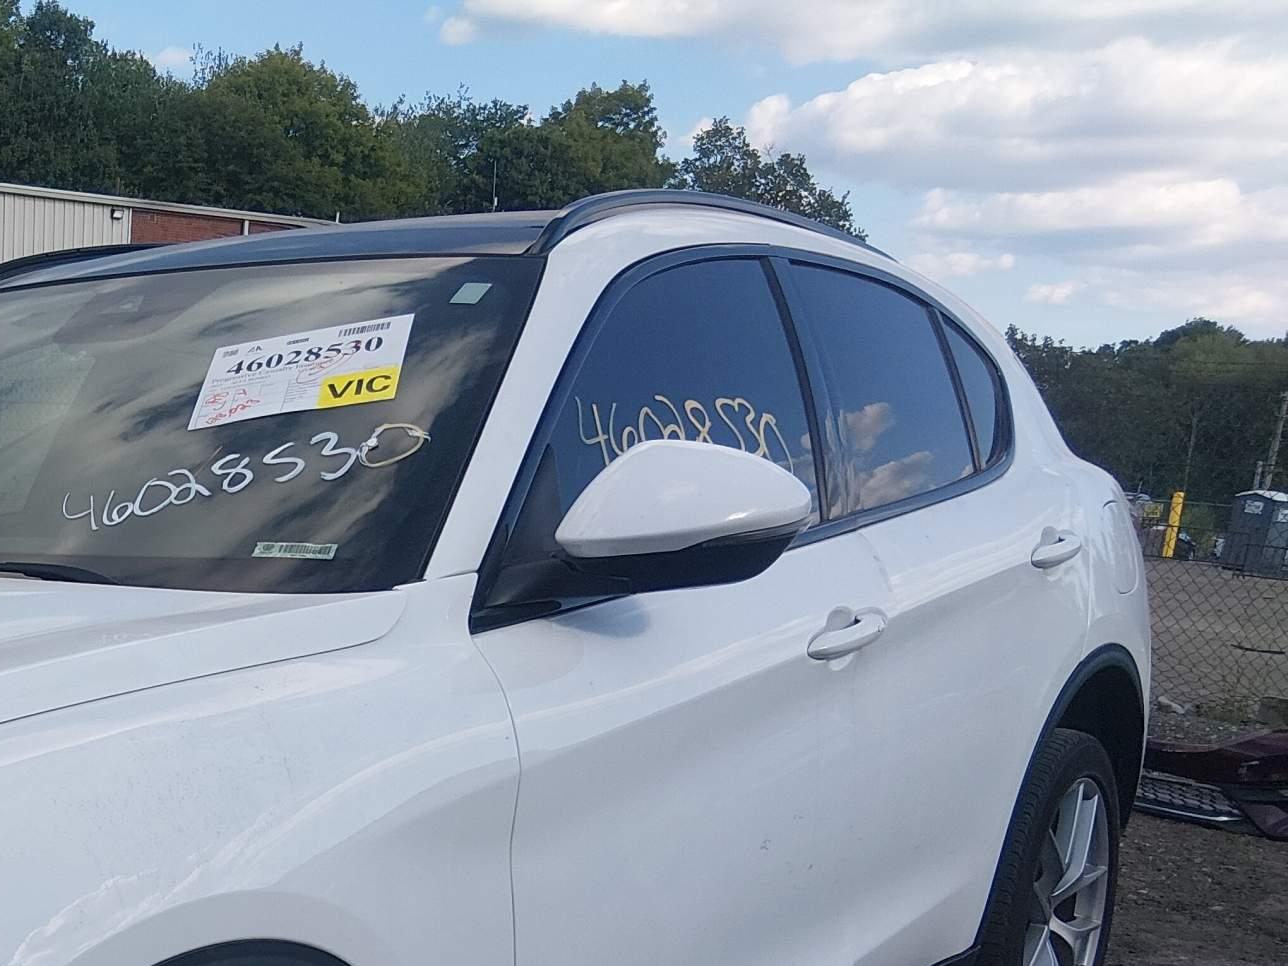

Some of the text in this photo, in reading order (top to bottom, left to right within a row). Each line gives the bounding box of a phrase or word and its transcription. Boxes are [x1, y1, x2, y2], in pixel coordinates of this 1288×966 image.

[226, 336, 384, 375] 46028530
[327, 374, 392, 400] VIC
[62, 421, 431, 531] 46028530
